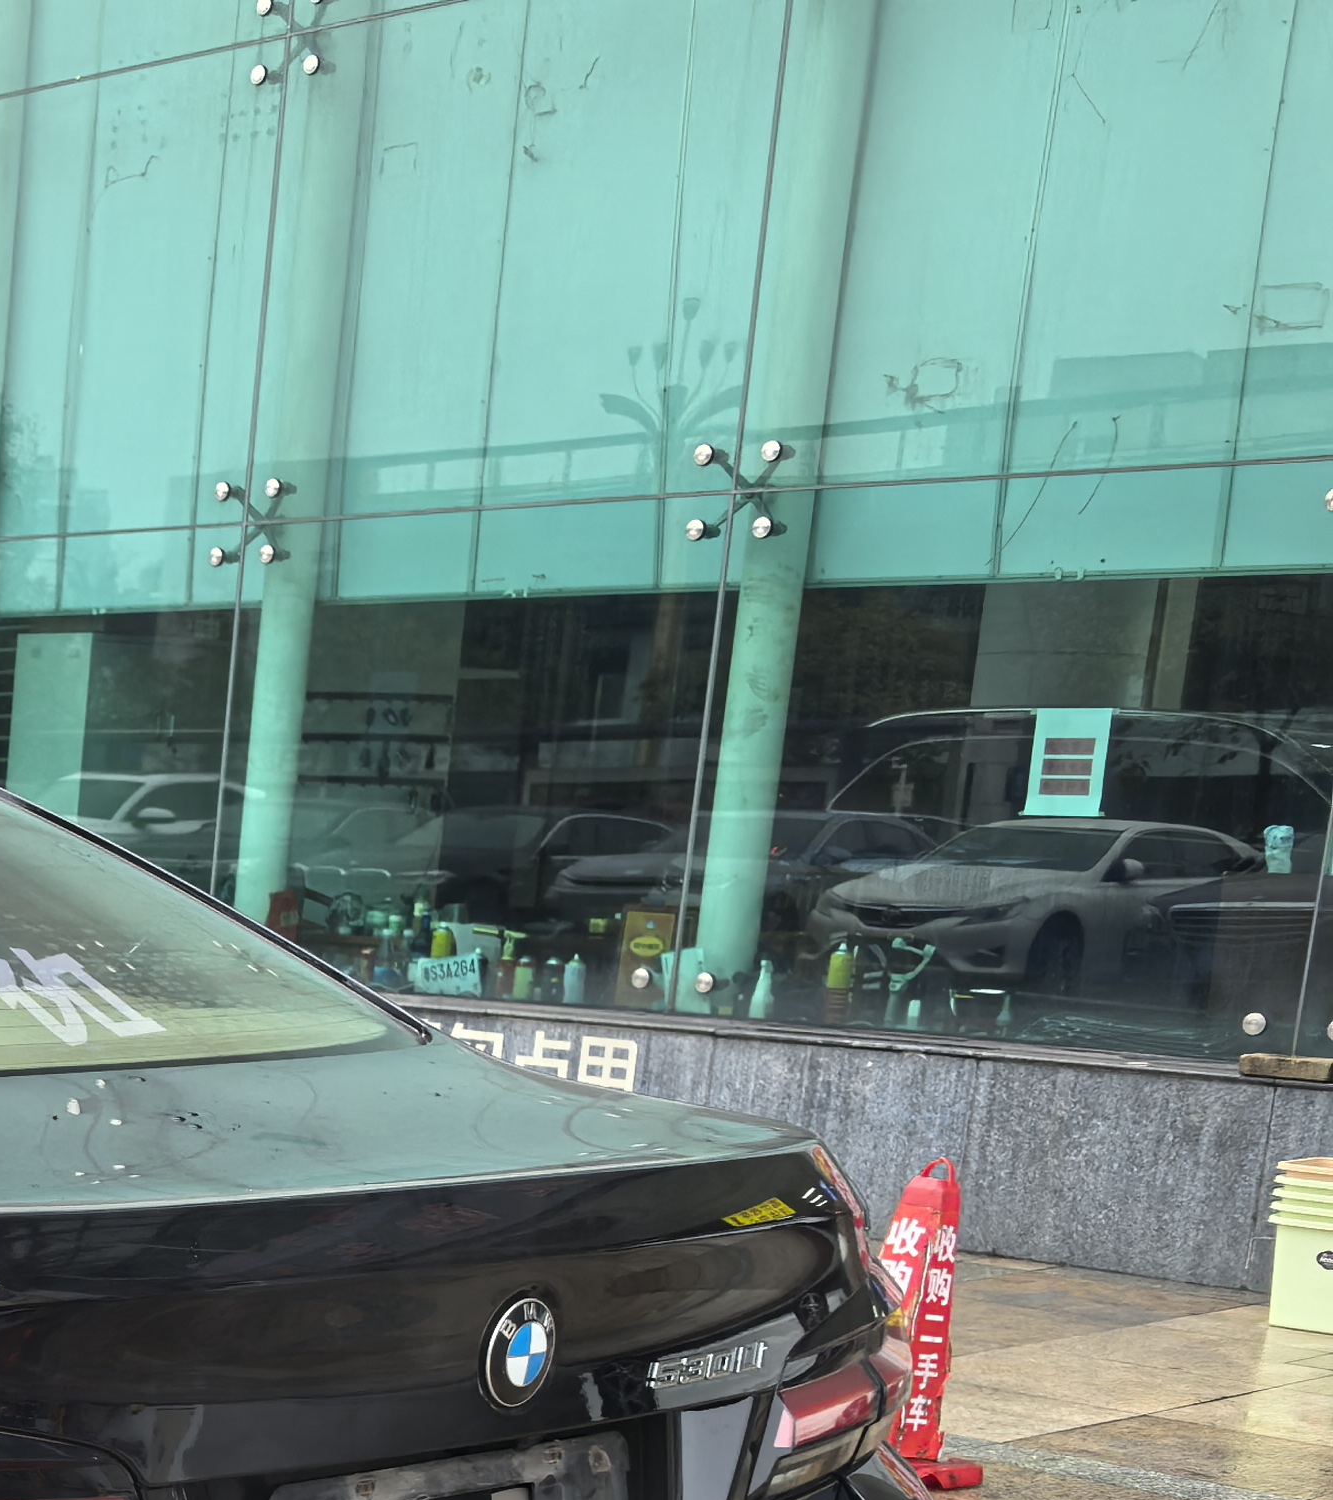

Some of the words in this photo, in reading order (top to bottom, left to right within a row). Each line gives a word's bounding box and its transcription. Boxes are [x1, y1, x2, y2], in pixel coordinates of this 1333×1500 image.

[905, 1225, 956, 1432] 收购二手车
